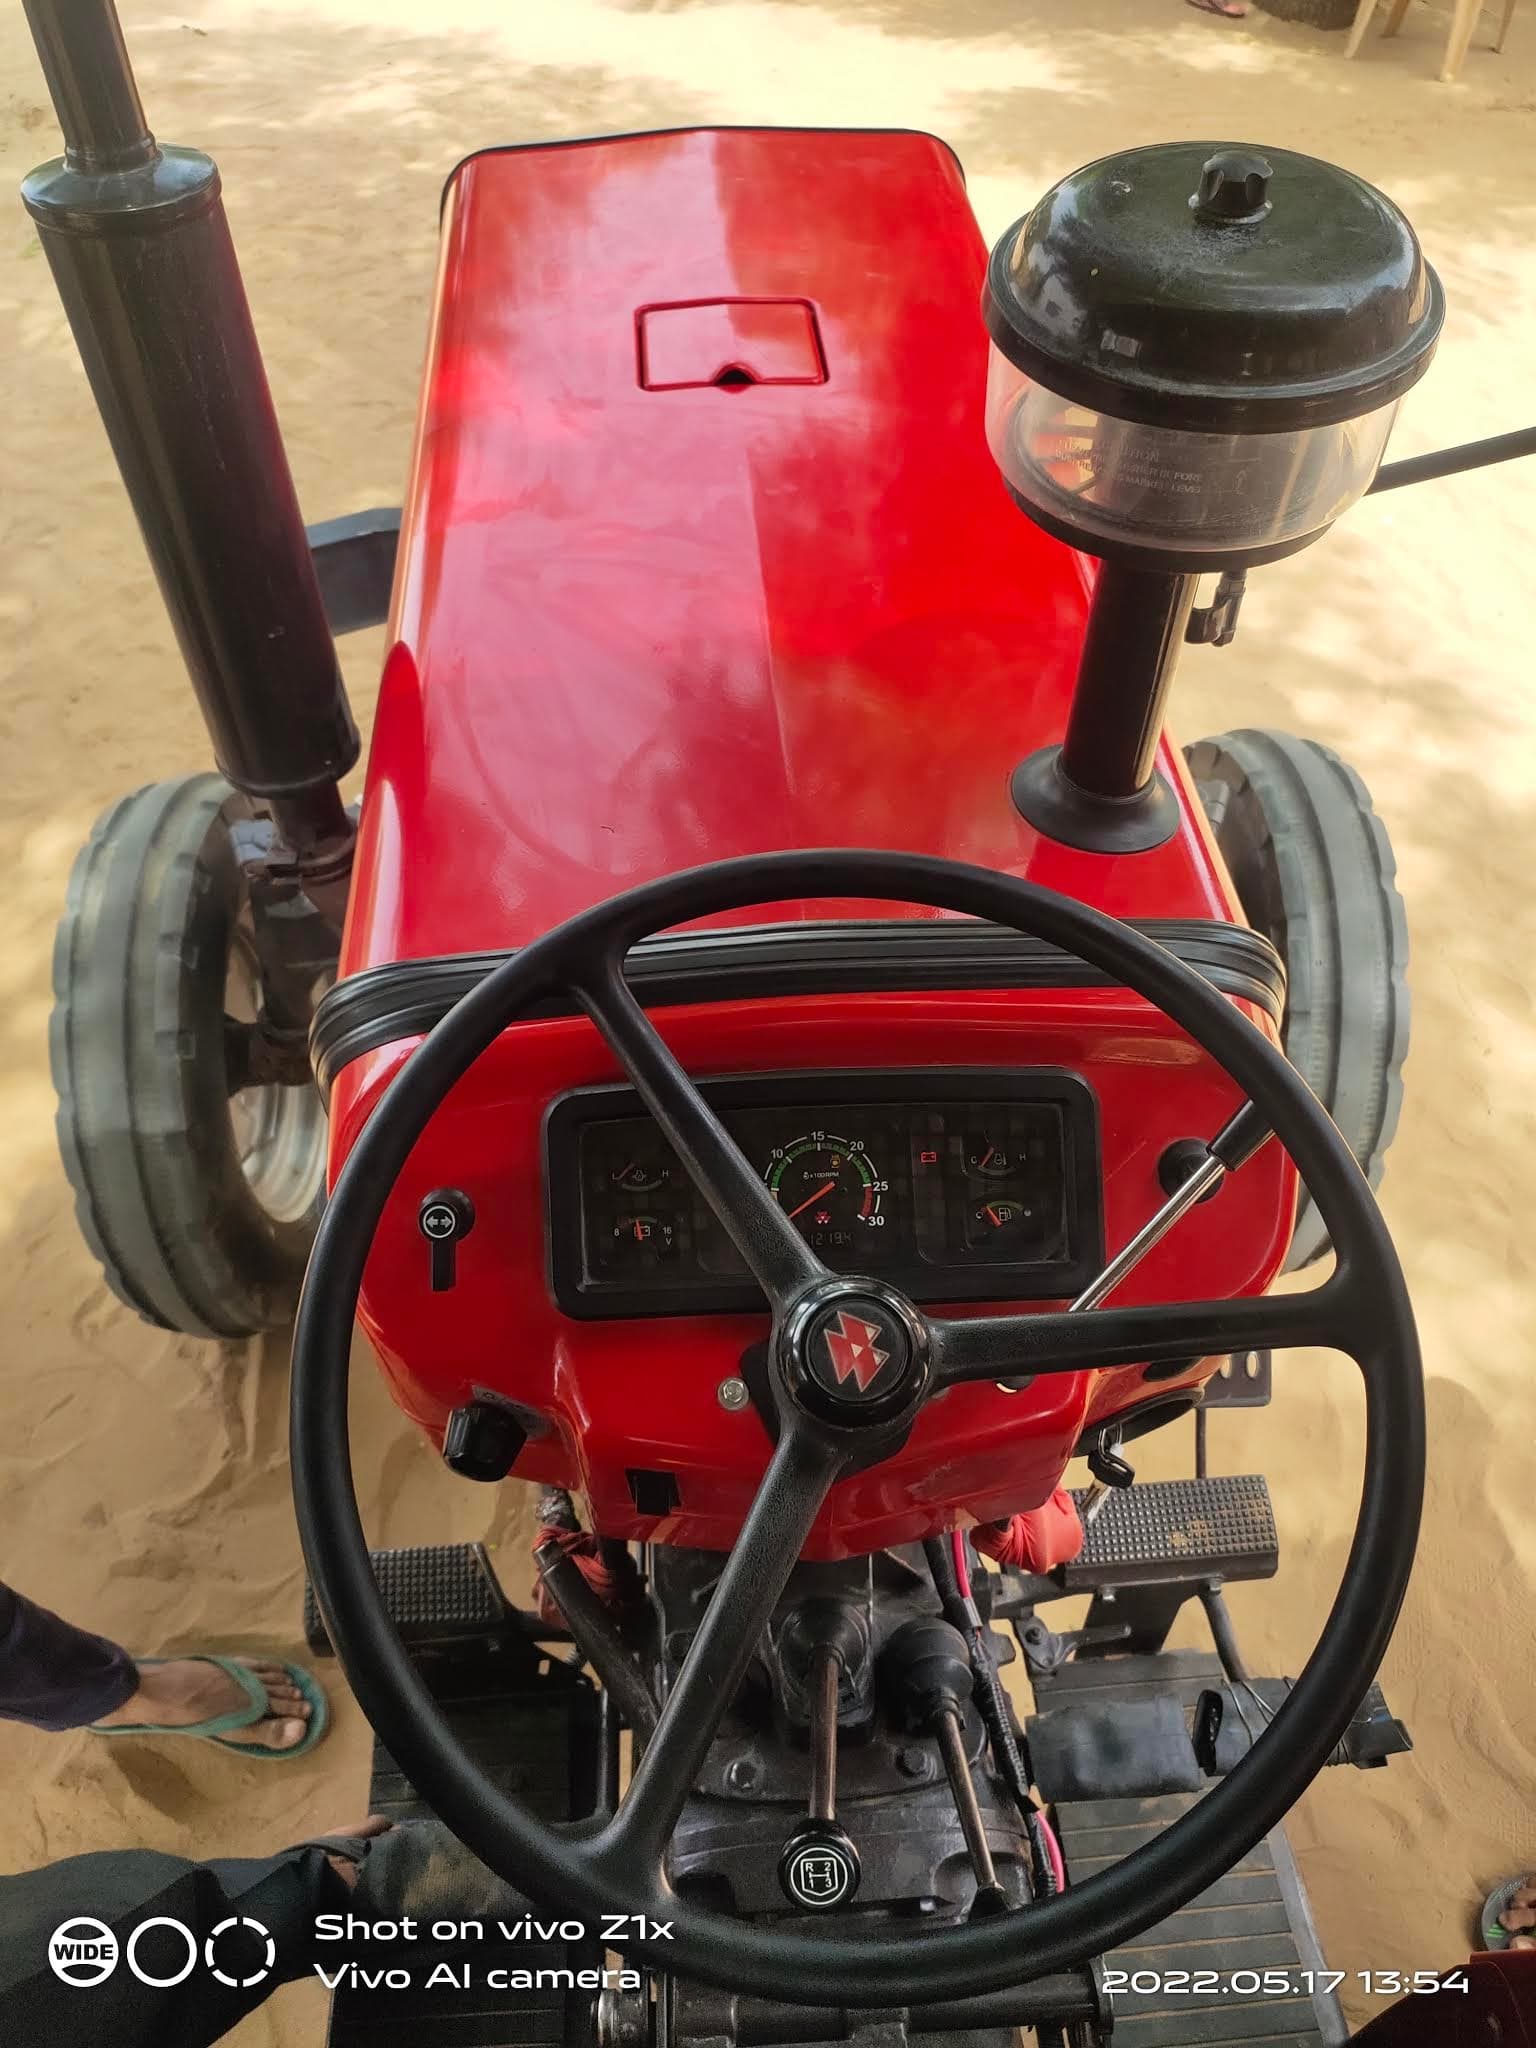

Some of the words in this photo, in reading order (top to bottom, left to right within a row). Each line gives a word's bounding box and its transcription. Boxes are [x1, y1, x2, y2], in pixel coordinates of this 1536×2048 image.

[811, 1131, 825, 1141] 15
[849, 1141, 864, 1151] 20
[770, 1149, 784, 1159] 10
[662, 1170, 669, 1178] H
[873, 1181, 888, 1192] 25
[868, 1216, 885, 1226] 30
[665, 1238, 672, 1246] V
[805, 1862, 814, 1872] R
[824, 1862, 831, 1872] 2
[808, 1879, 814, 1889] 1
[825, 1878, 832, 1887] 3
